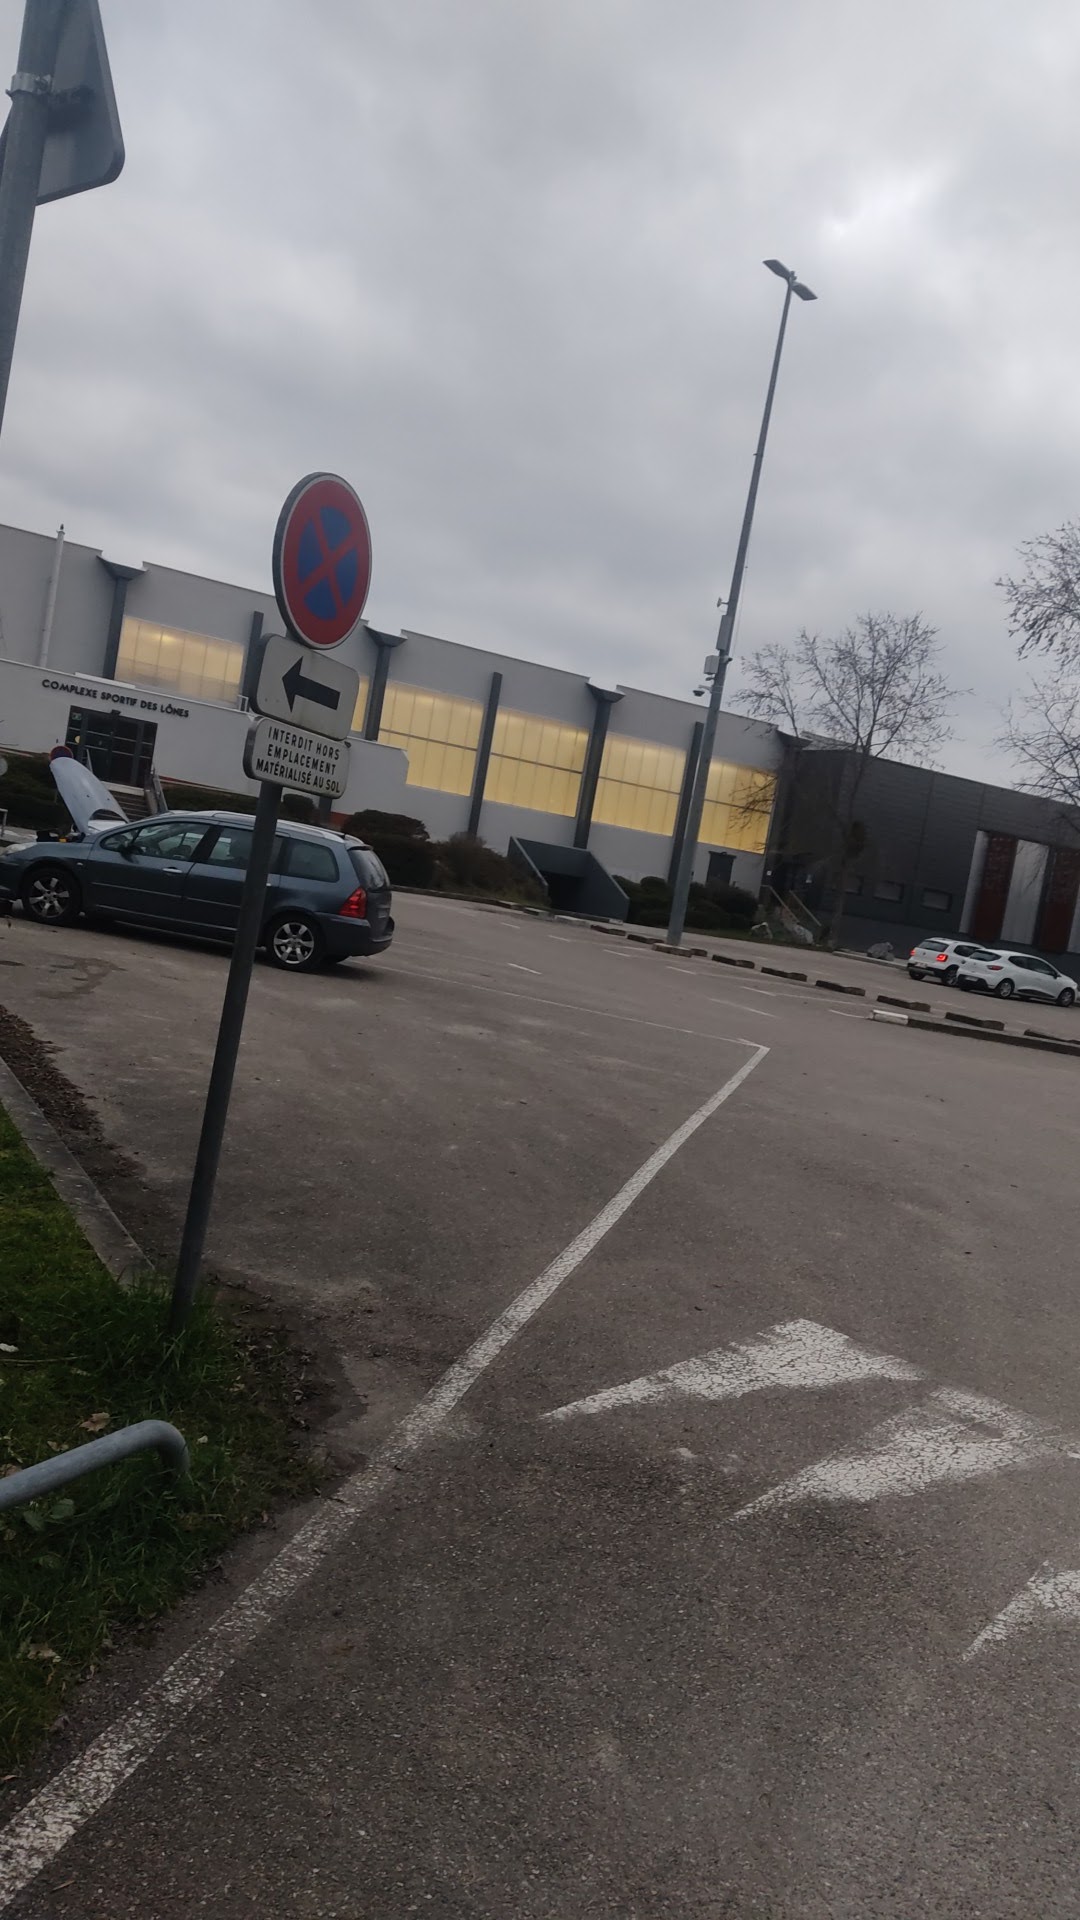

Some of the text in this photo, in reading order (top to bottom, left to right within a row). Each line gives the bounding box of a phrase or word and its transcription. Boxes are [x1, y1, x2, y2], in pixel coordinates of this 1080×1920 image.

[42, 679, 189, 718] COMPLEXE SPORTIF DES LÔNES
[267, 744, 336, 776] EMPLACEMENT
[268, 726, 340, 760] INTERDIT HORS
[256, 758, 340, 793] MATÉRIALISÉ AU SOL
